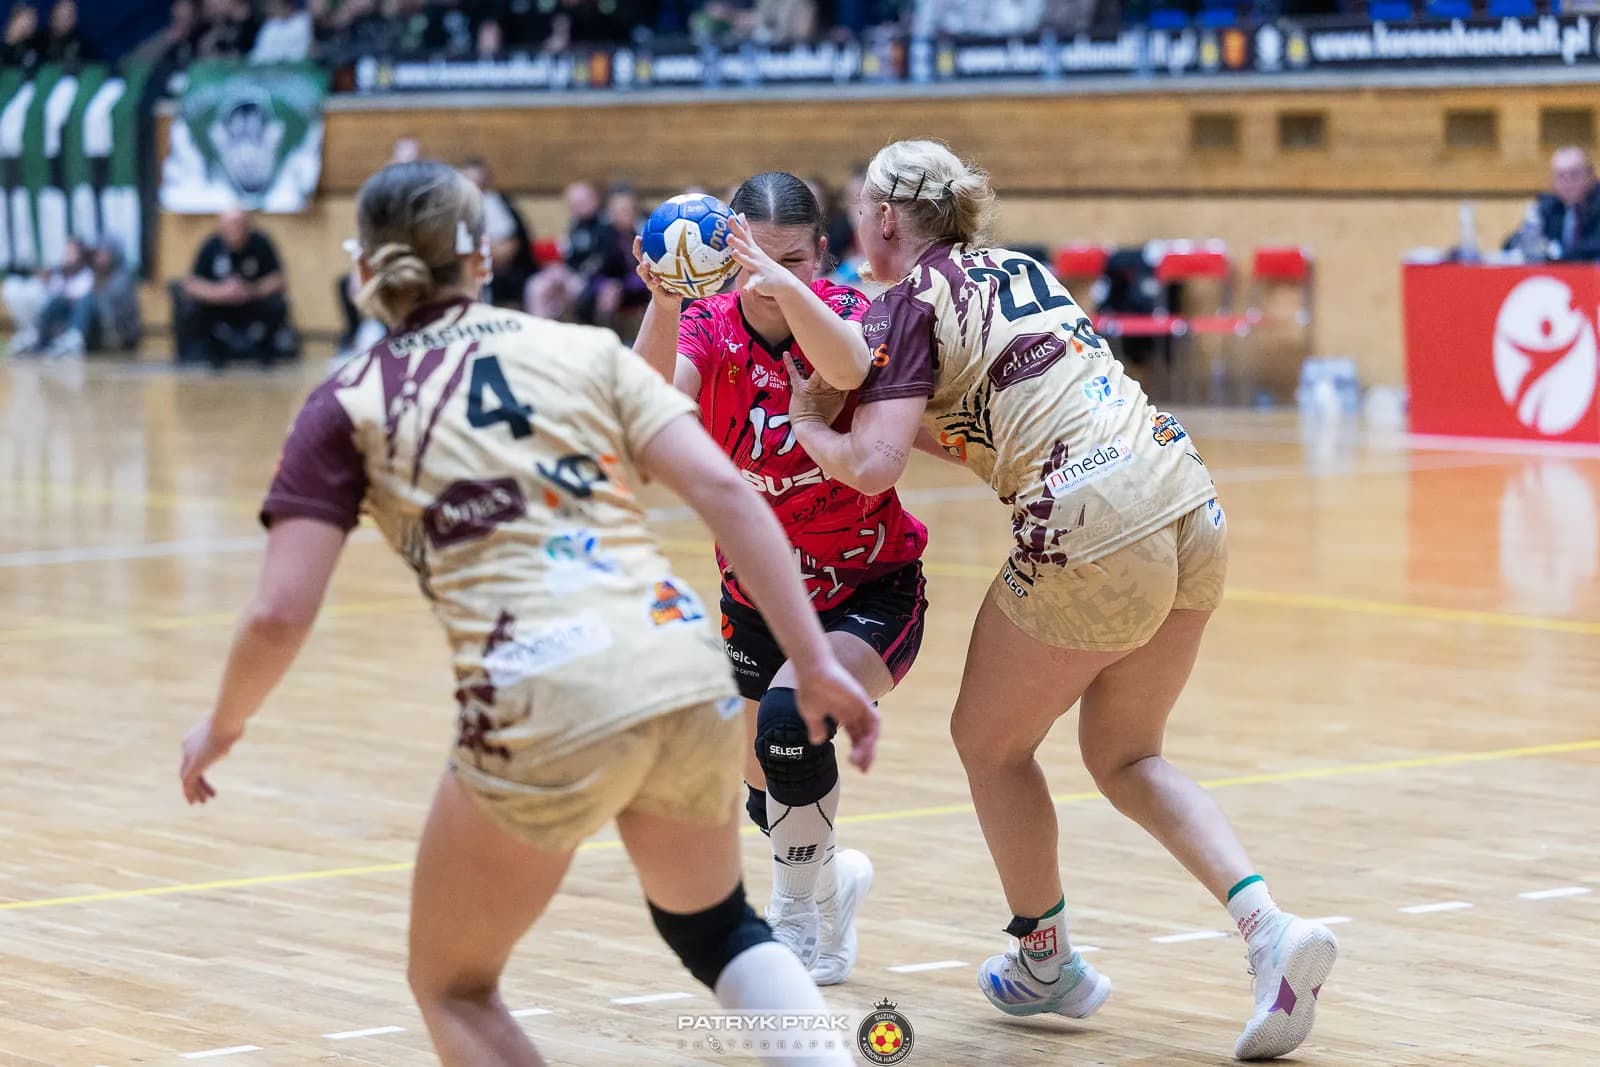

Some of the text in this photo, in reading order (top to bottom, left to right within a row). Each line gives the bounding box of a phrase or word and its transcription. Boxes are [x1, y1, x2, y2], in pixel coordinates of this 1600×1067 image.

[967, 258, 1074, 322] 22
[1003, 341, 1056, 377] elmas
[466, 355, 534, 439] 4
[750, 407, 797, 460] 17
[769, 744, 804, 757] SELECT
